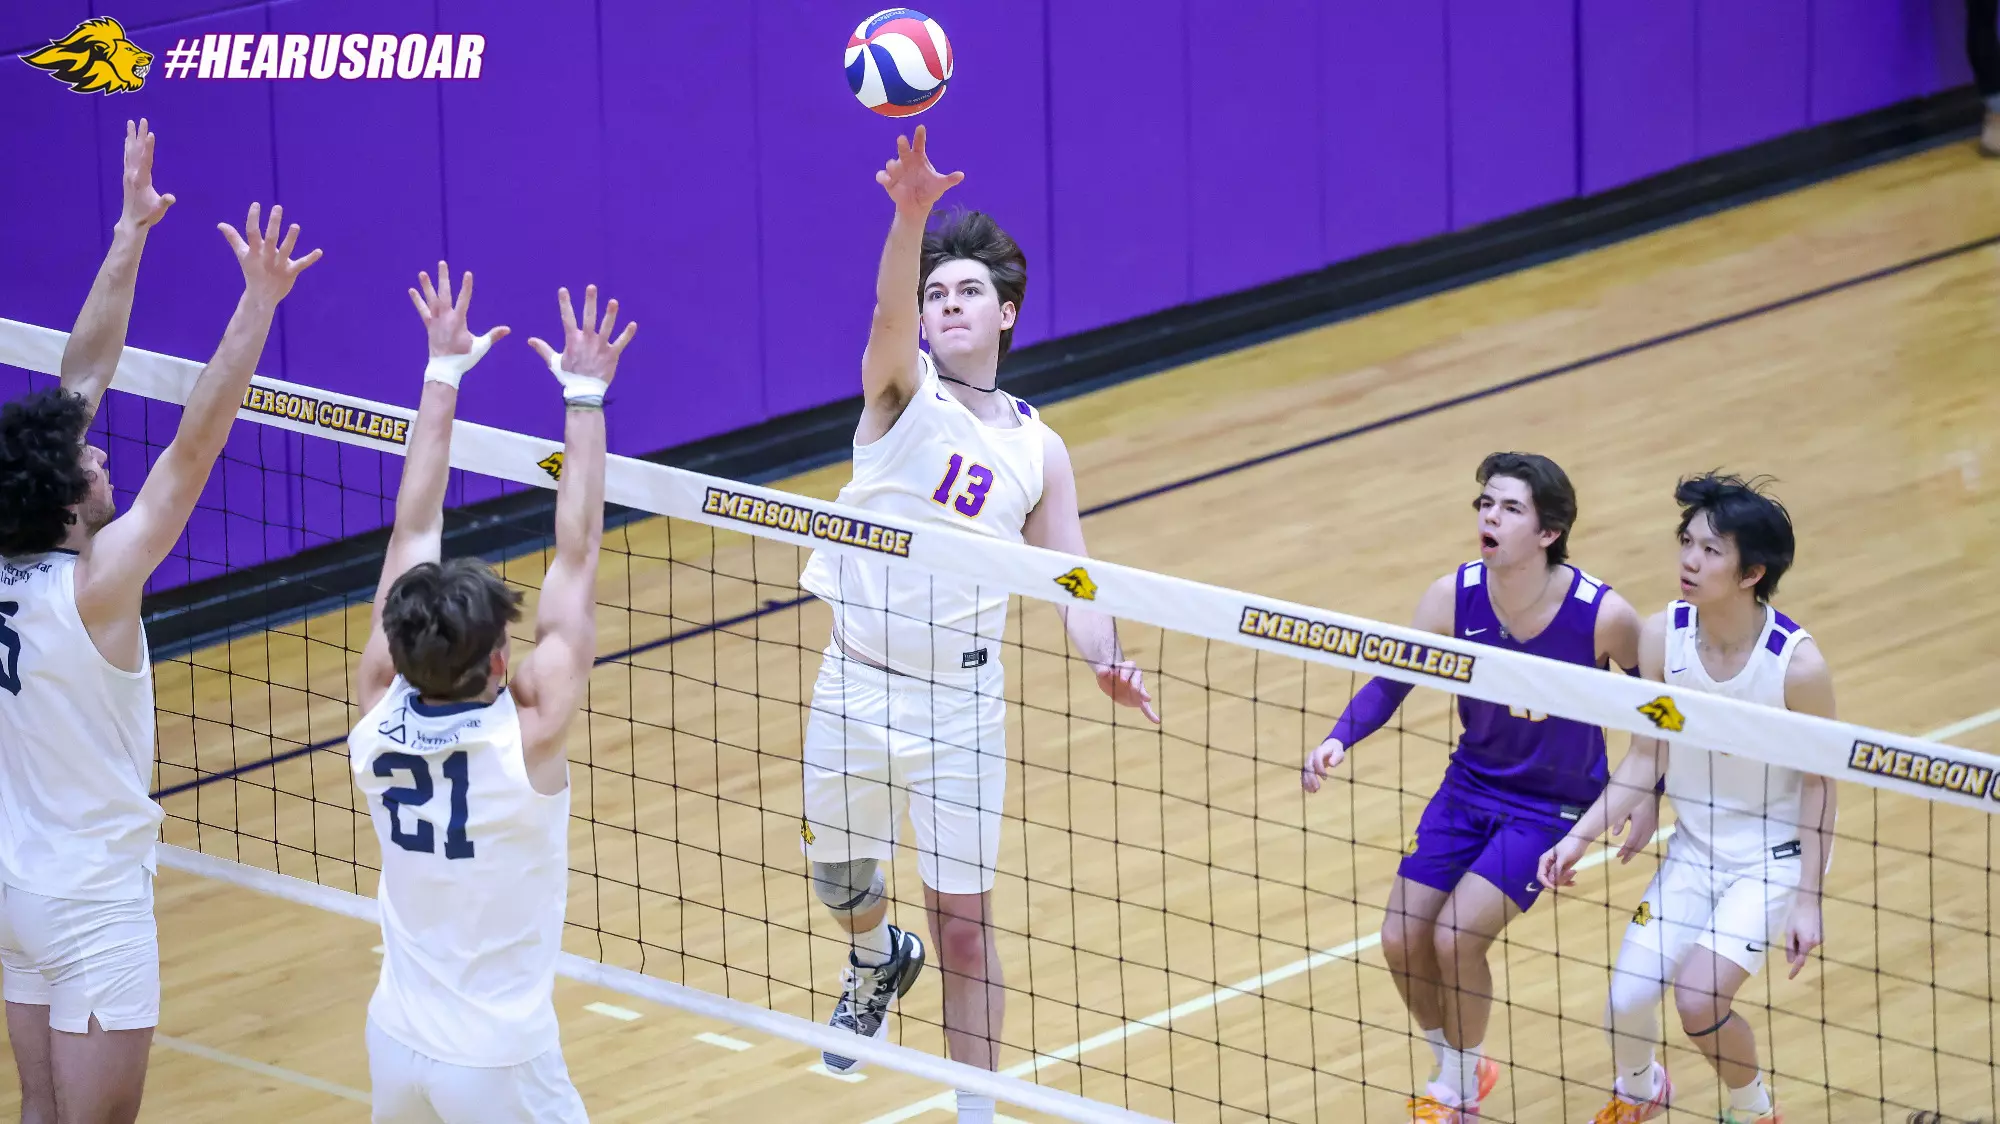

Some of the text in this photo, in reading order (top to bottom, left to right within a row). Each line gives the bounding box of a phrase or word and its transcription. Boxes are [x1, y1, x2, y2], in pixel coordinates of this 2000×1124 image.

[242, 385, 408, 443] ERSON COLLEGE
[931, 453, 994, 519] 13
[704, 488, 911, 555] EMERSON COLLEGE
[1240, 608, 1474, 681] EMERSON COLLEGE
[1850, 742, 1990, 797] EMERSON
[373, 751, 475, 860] 21
